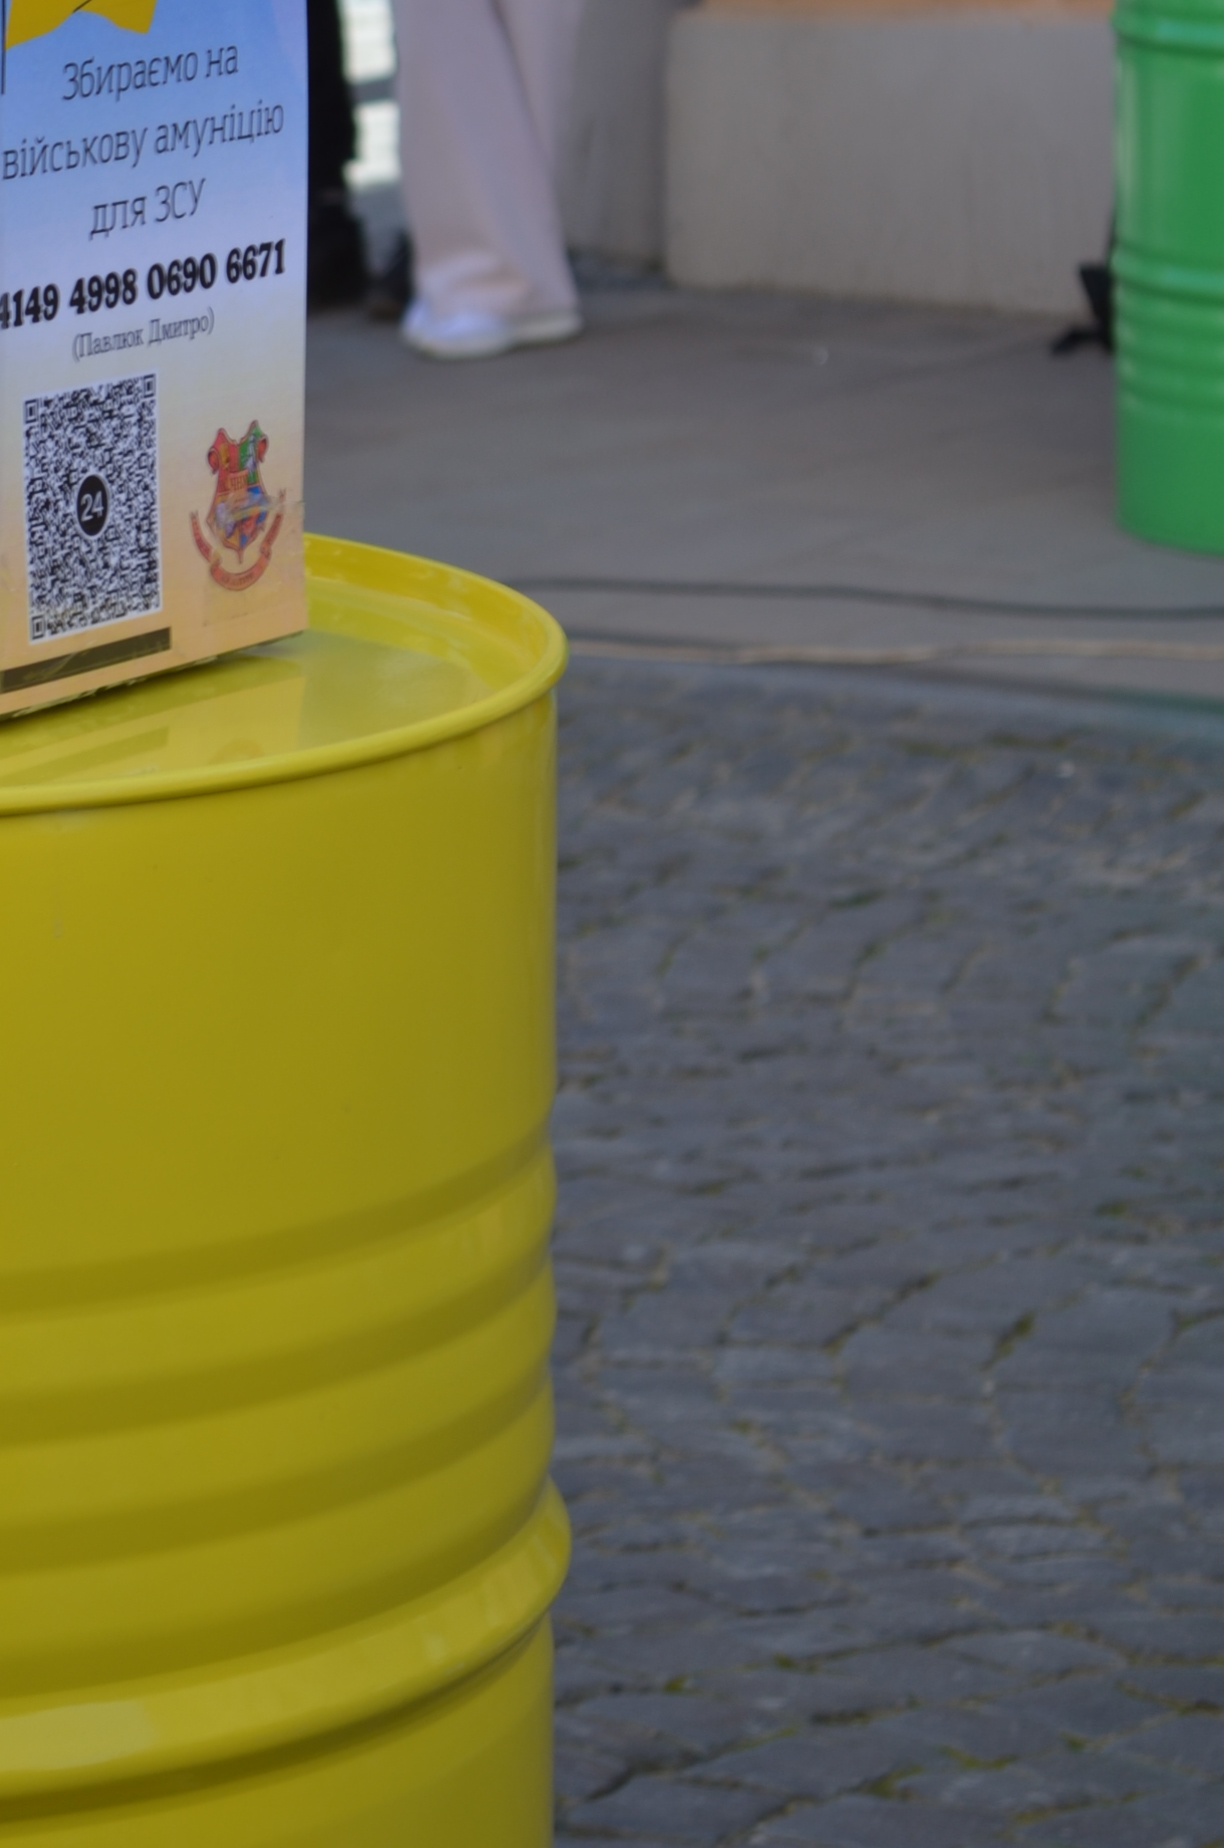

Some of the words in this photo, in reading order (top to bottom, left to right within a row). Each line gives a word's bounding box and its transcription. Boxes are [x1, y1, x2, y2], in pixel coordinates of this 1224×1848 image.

[61, 50, 199, 102] Збираємо
[205, 45, 239, 78] на
[1, 127, 148, 181] військову
[155, 99, 285, 158] амуніцію
[88, 195, 147, 242] для
[155, 178, 206, 223] ЗСУ
[68, 267, 138, 315] 4998
[146, 252, 217, 300] 0690
[225, 238, 286, 284] 6671
[72, 328, 144, 363] (Павлюк
[148, 306, 216, 346] Дмитро)
[80, 492, 105, 523] 24
